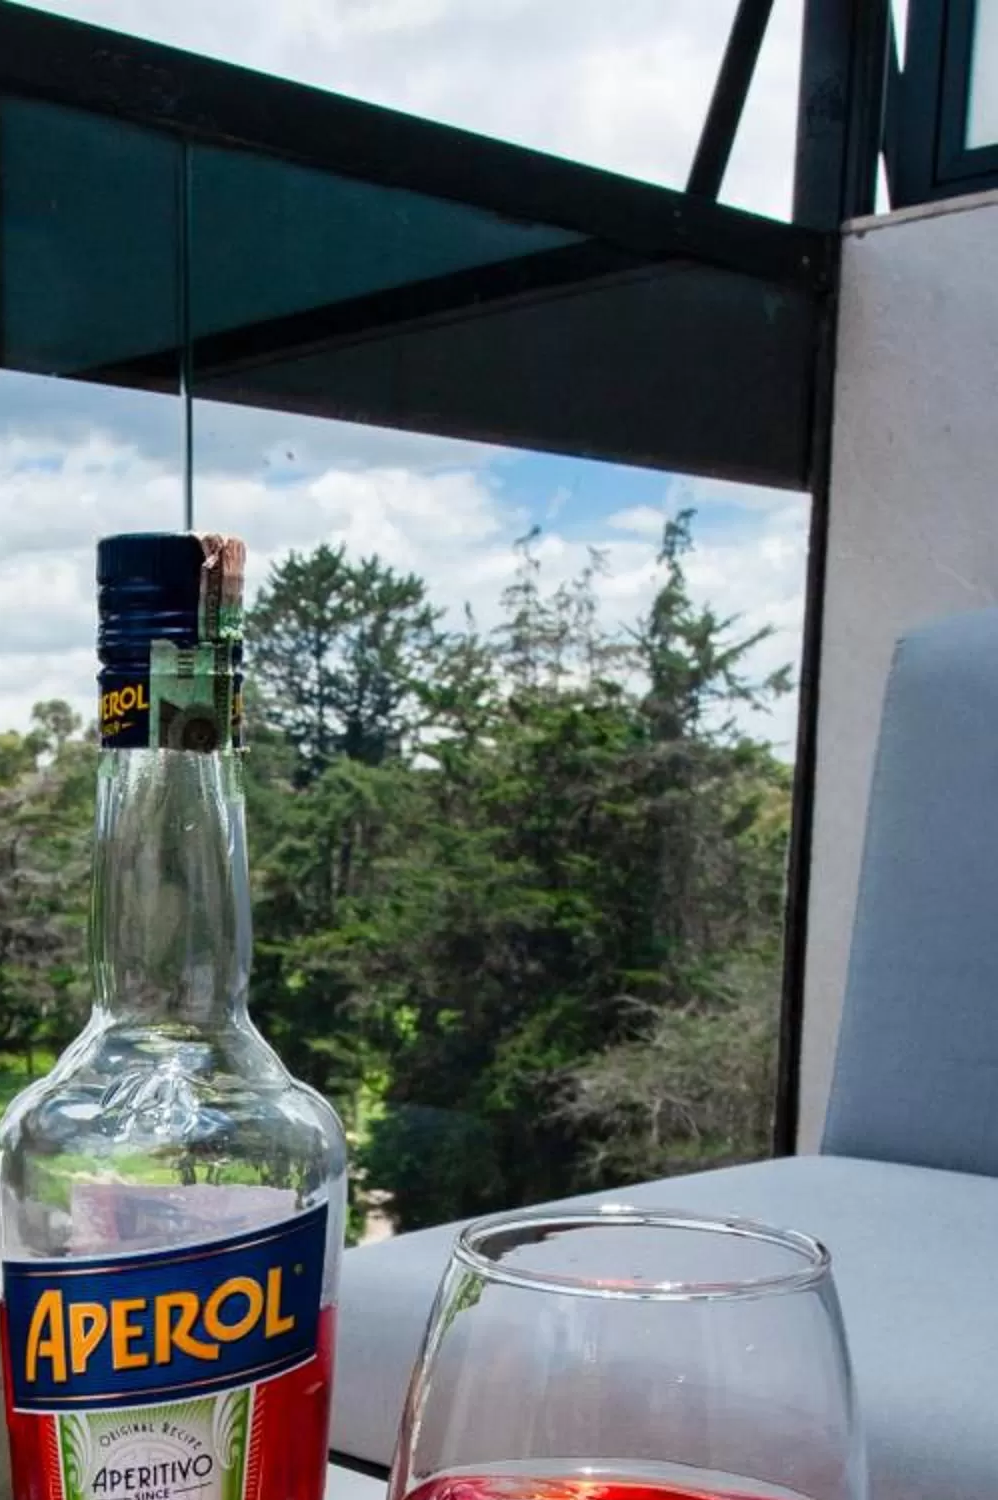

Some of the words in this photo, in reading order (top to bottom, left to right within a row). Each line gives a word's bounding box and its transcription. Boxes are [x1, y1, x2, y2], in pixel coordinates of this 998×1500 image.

[98, 684, 150, 720] EROL
[25, 1266, 295, 1383] APEROL
[100, 1423, 154, 1447] ORIGINAL
[162, 1421, 202, 1451] RECIPE
[91, 1453, 213, 1493] APERITIVO
